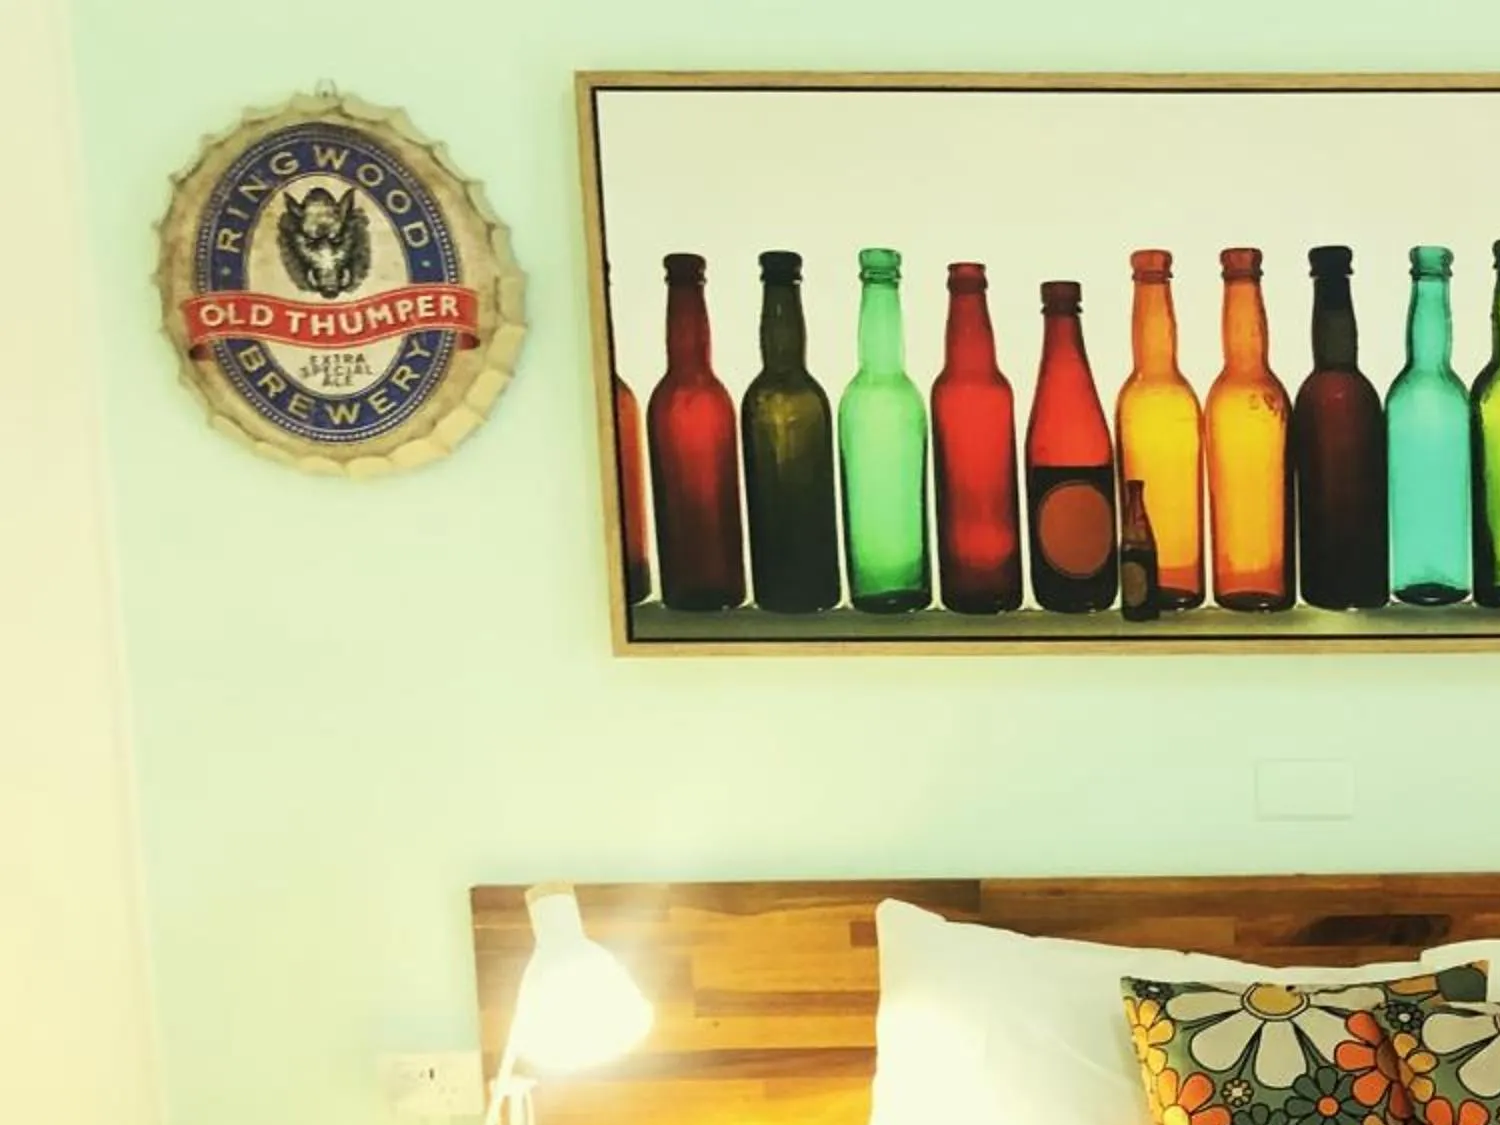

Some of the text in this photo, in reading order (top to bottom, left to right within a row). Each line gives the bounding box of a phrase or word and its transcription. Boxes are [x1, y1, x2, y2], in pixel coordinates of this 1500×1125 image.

[217, 144, 430, 254] RINGWOOD
[200, 294, 459, 336] OLD THUMPER
[237, 335, 432, 426] BREWERY
